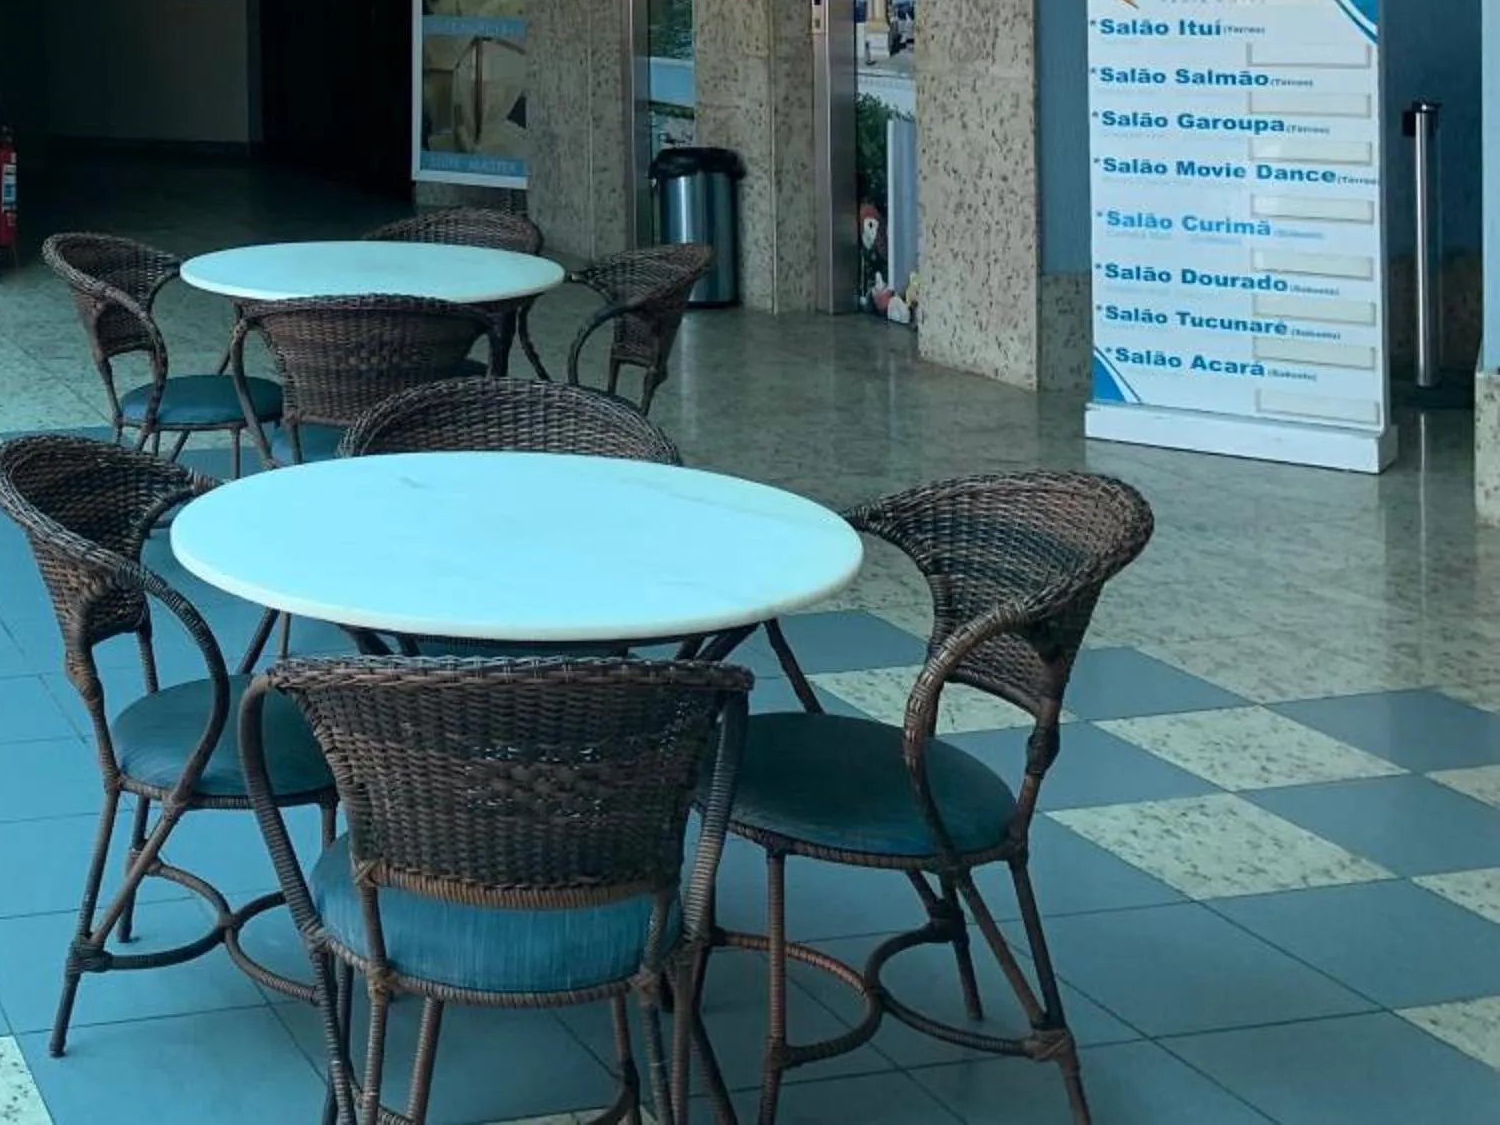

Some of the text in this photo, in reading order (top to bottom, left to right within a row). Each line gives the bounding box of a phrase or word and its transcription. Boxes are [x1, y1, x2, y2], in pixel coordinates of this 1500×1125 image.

[1100, 19, 1169, 36] Salão
[1179, 19, 1221, 36] Ituí
[1100, 67, 1167, 84] Salão
[1175, 69, 1269, 87] Salmão
[1102, 111, 1168, 128] Salão
[1177, 114, 1285, 135] Garoupa
[1103, 158, 1167, 175] Salão
[1176, 161, 1246, 179] Movie
[1257, 165, 1337, 184] Dance
[1107, 211, 1173, 230] Salão
[1181, 215, 1271, 236] Curimã
[1104, 263, 1172, 283] Salão
[1181, 269, 1288, 292] Dourado
[1105, 306, 1168, 324] Salão
[1176, 312, 1287, 335] Tucunaré
[1115, 347, 1182, 367] Salão
[1190, 355, 1265, 377] Acará
